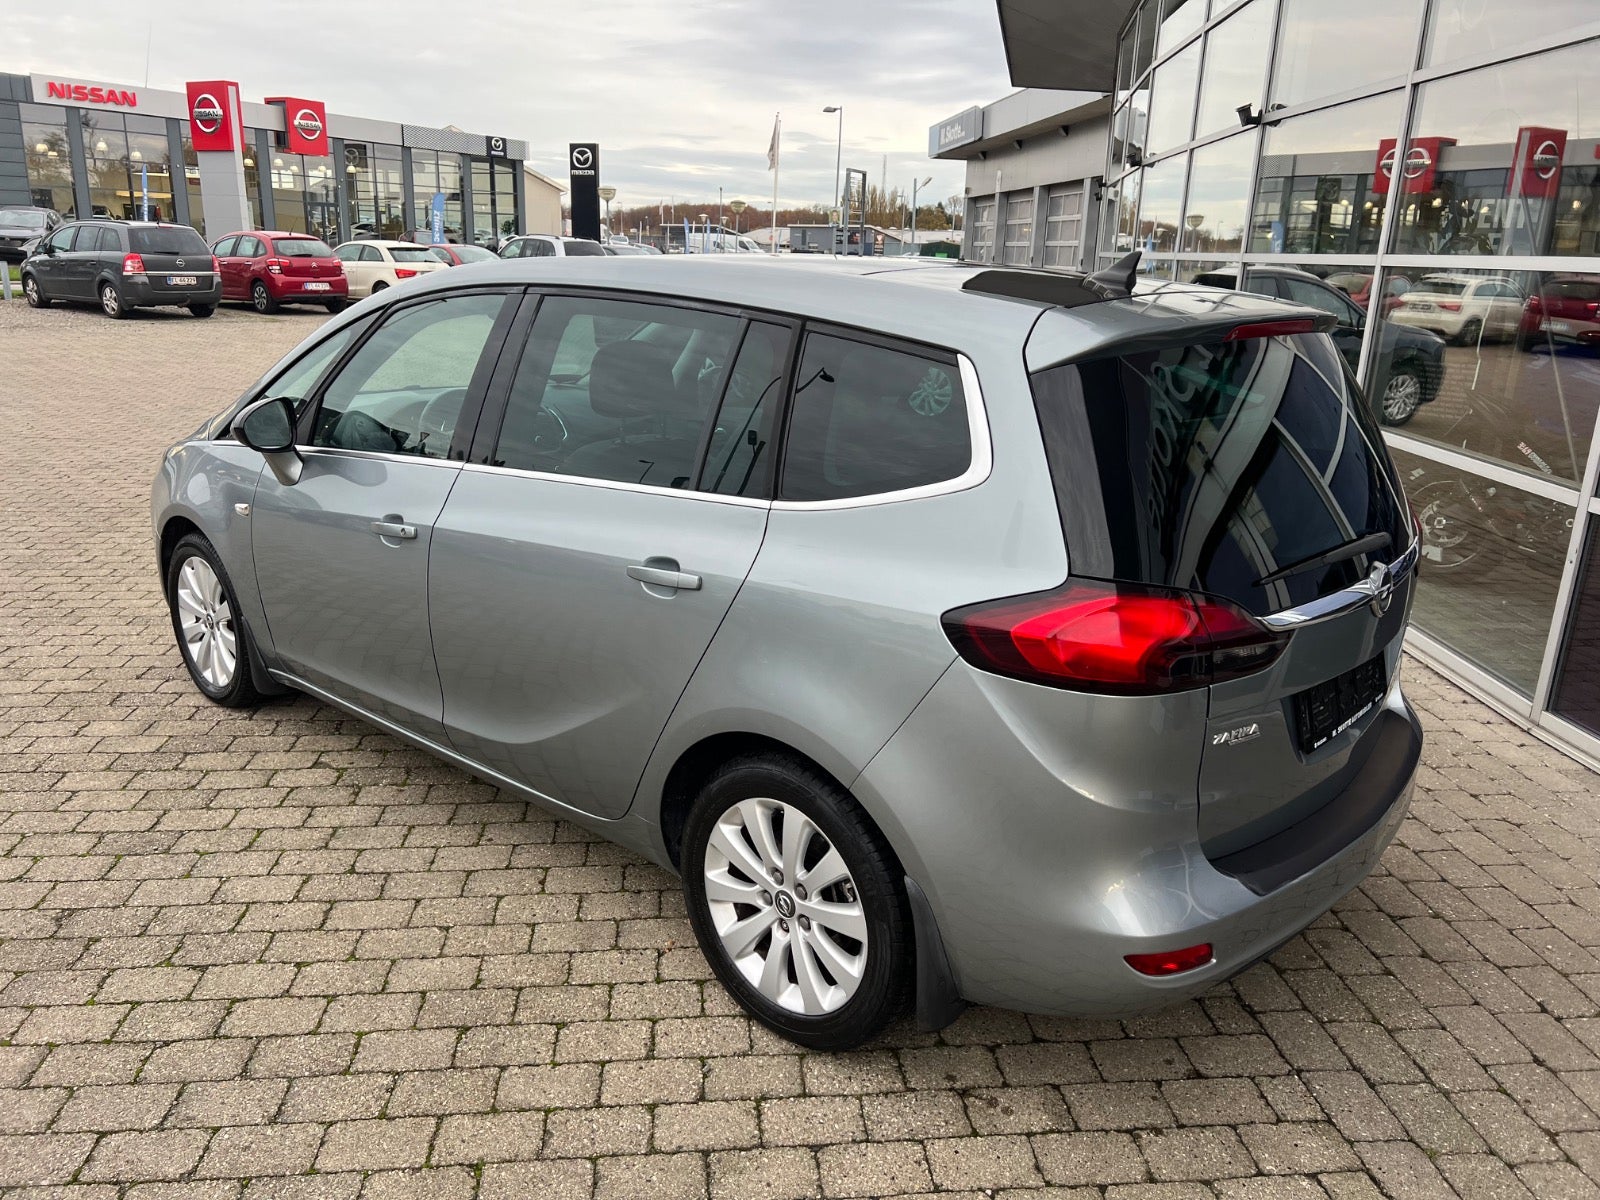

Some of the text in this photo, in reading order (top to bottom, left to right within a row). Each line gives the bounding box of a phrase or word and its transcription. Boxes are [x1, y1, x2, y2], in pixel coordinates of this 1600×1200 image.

[47, 81, 137, 107] NISSAN
[195, 110, 219, 118] NISSAN
[297, 121, 321, 129] NISSAN
[1213, 723, 1259, 745] ZAFIRA
